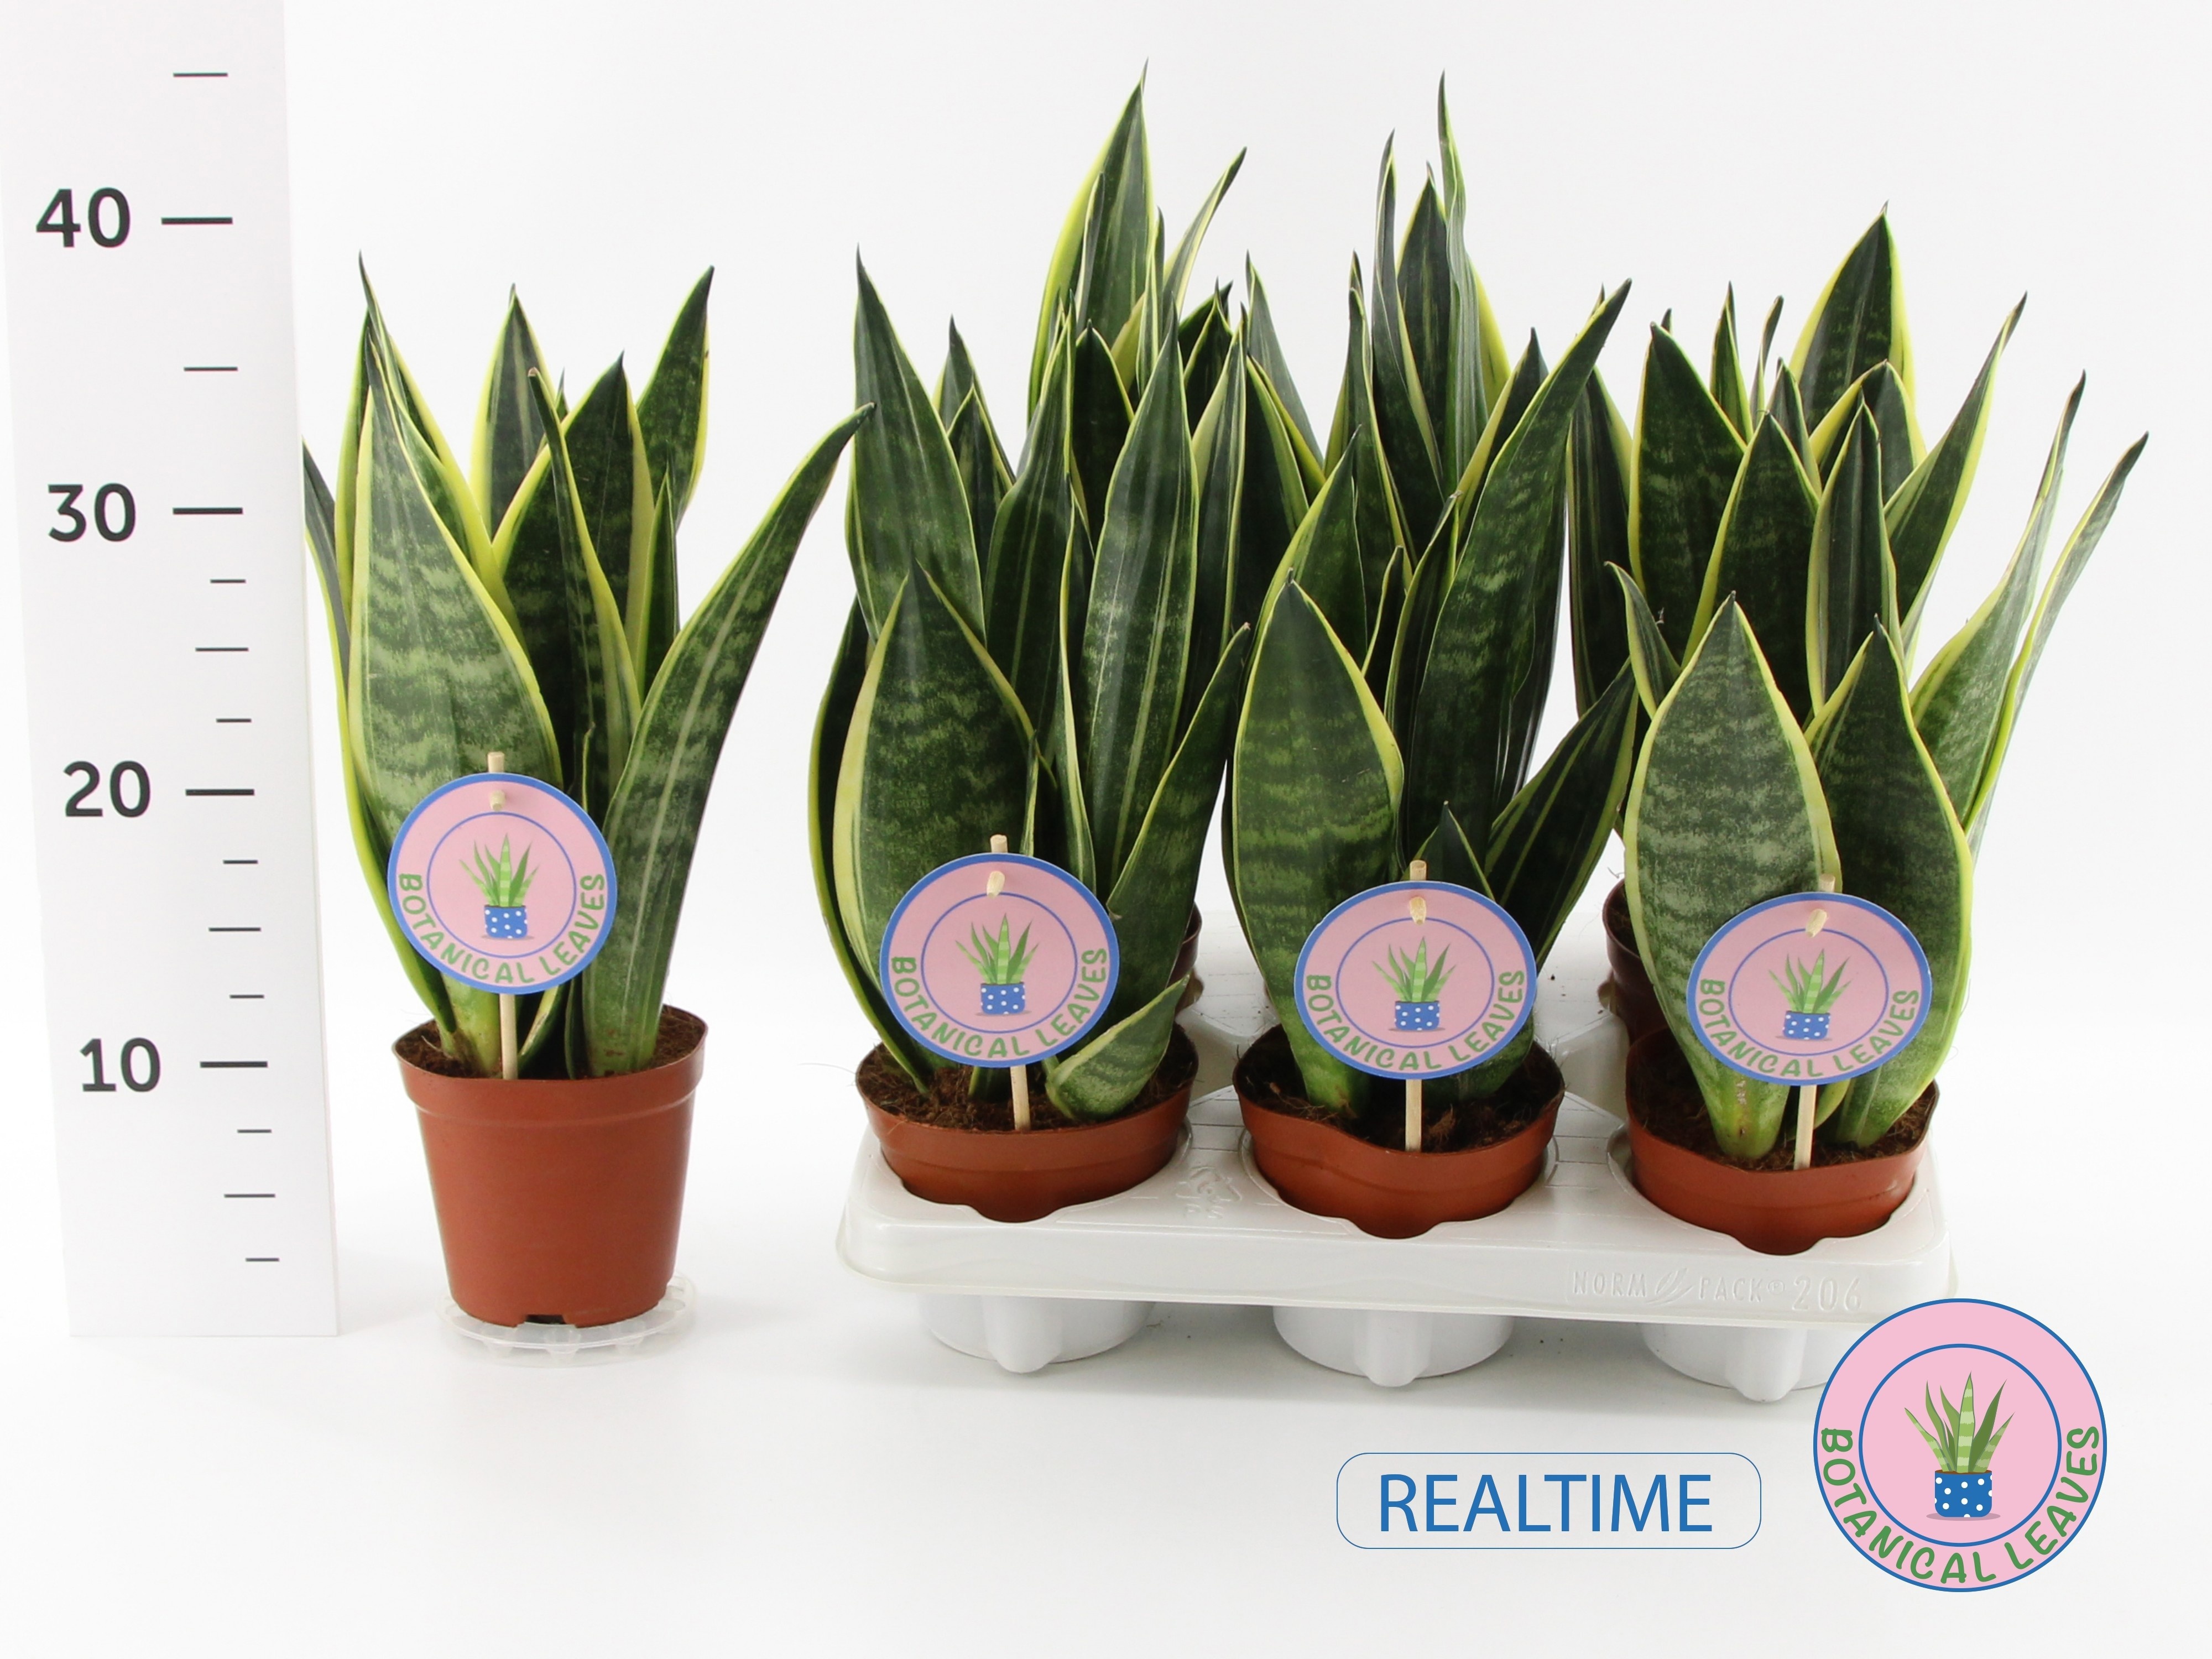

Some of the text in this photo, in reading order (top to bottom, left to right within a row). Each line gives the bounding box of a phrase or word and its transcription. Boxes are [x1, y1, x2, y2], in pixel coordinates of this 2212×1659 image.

[35, 187, 132, 248] 40
[48, 482, 136, 542] 30
[62, 760, 150, 817] 20
[399, 873, 605, 984] BOTANICAL LEAVES
[891, 948, 1107, 1058] BOTANICAL LEAVES
[1306, 969, 1525, 1071] BOTANICAL LEAVES
[1698, 978, 1919, 1077] BOTANICAL LEAVES
[79, 1037, 161, 1092] 10
[1572, 1270, 1648, 1297] NORM
[1791, 1274, 1863, 1312] 206
